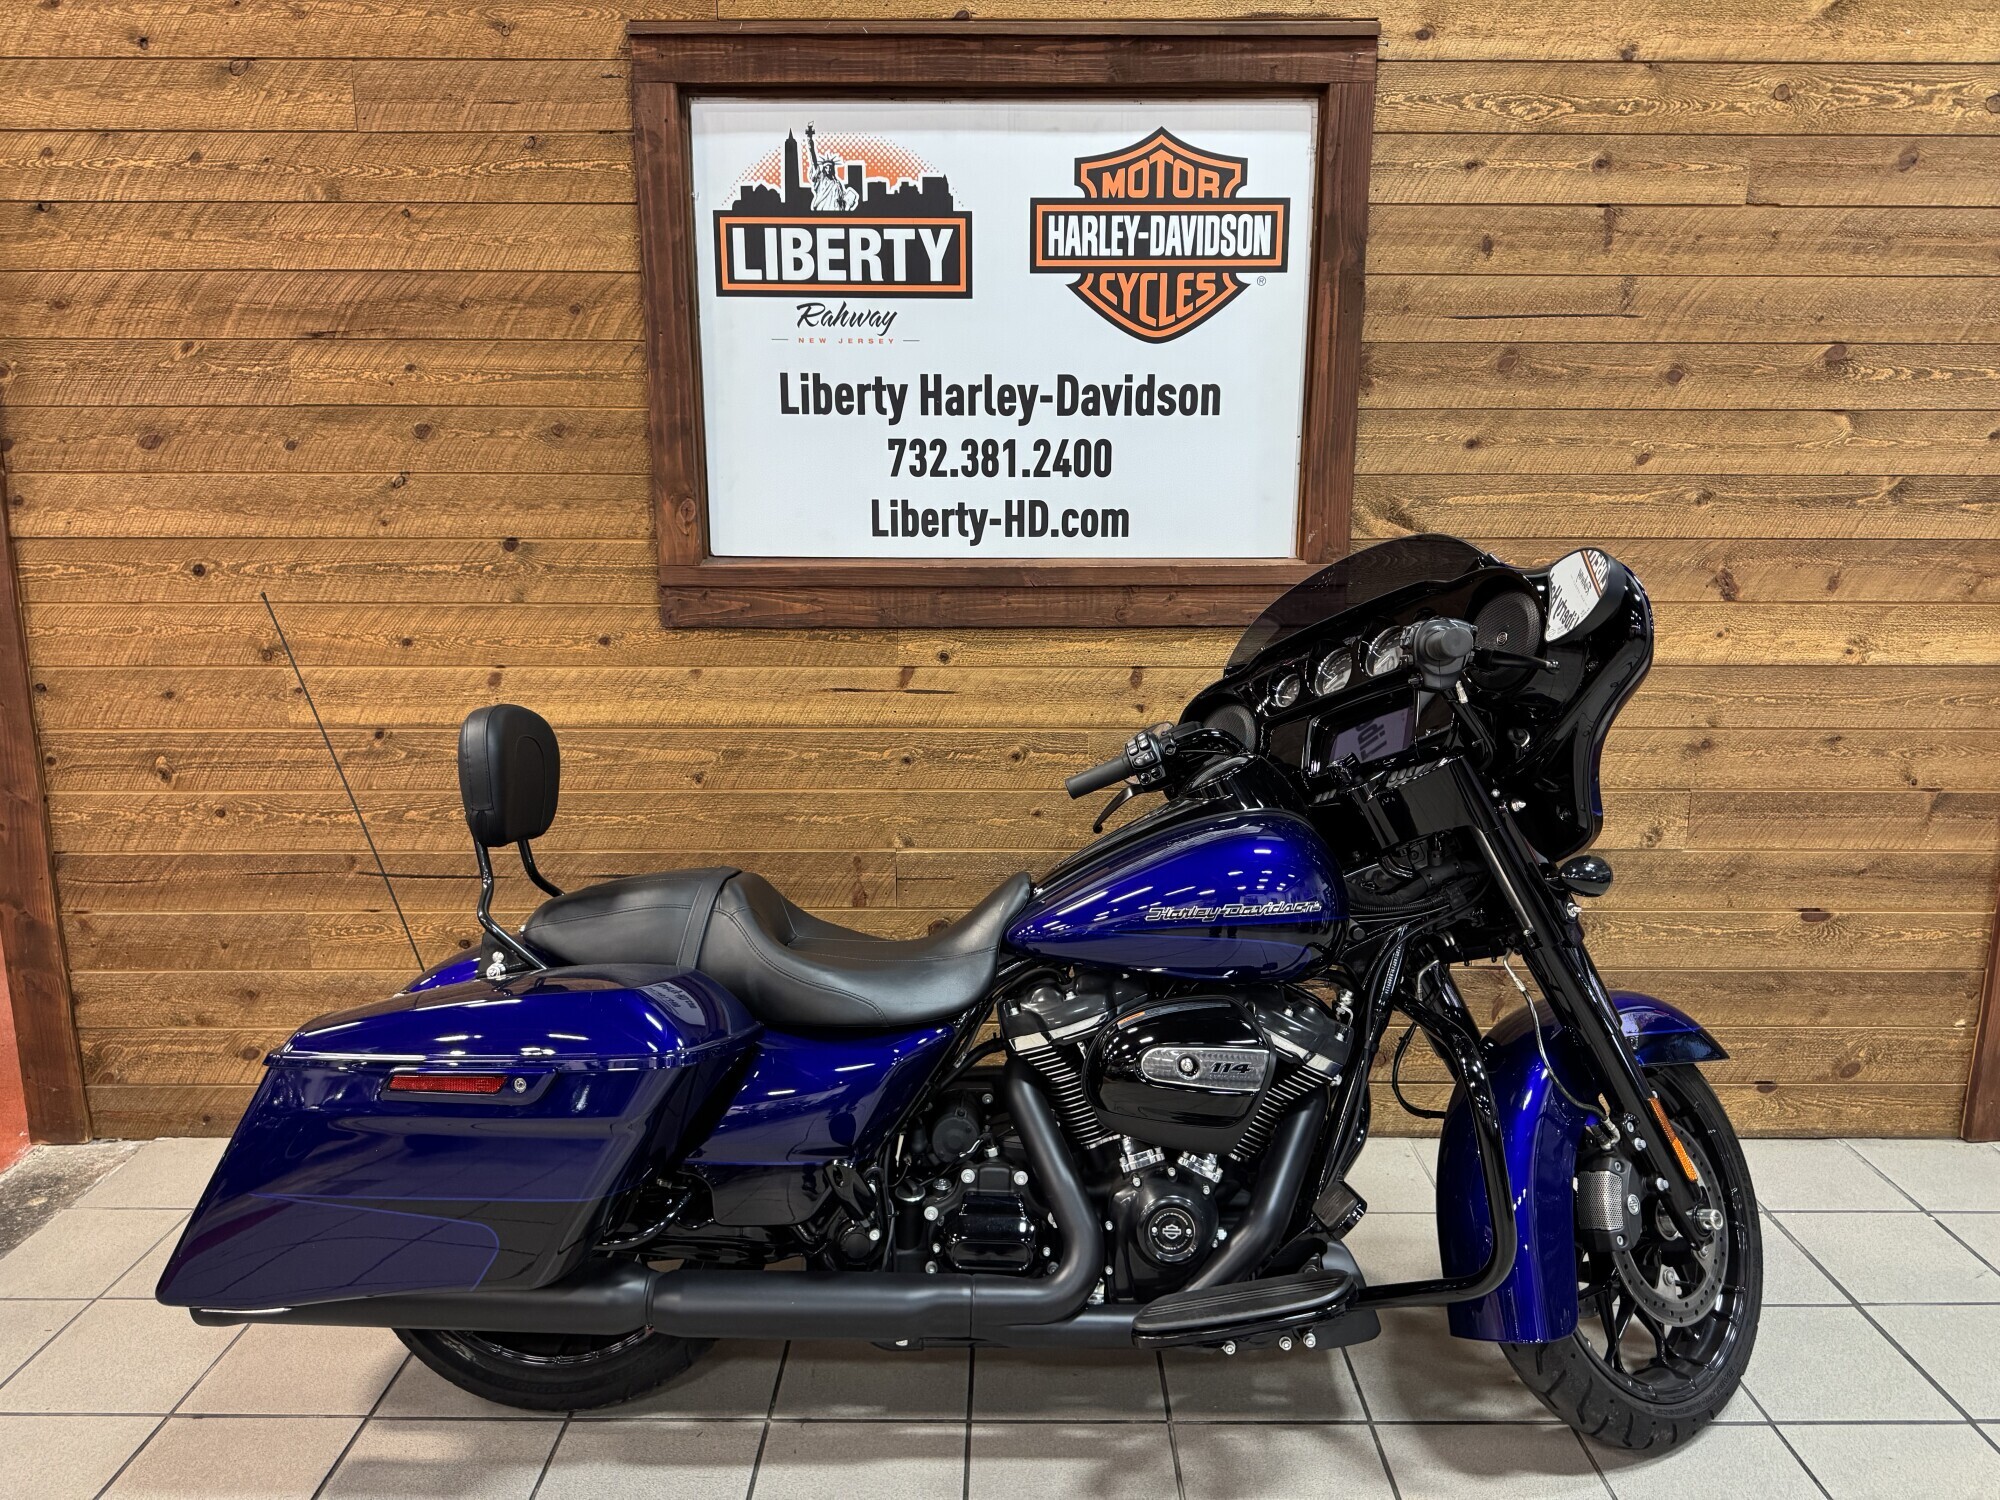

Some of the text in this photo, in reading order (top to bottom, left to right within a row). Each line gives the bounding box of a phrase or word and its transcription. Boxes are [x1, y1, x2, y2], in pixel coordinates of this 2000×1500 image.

[1102, 149, 1220, 198] MOTOR
[732, 227, 954, 283] LIBERTY
[1048, 214, 1272, 257] HARLEY-DAVIDSON
[796, 300, 898, 337] Rahway
[1099, 272, 1216, 328] CYCLES
[838, 337, 894, 345] JERSEY
[779, 372, 1221, 426] Liberty Harley-Davidson
[887, 438, 1112, 478] 732.381.2400
[871, 499, 1130, 546] Liberty-HD.com
[1145, 901, 1321, 922] Harley-Davidson
[1210, 1061, 1254, 1074] 114
